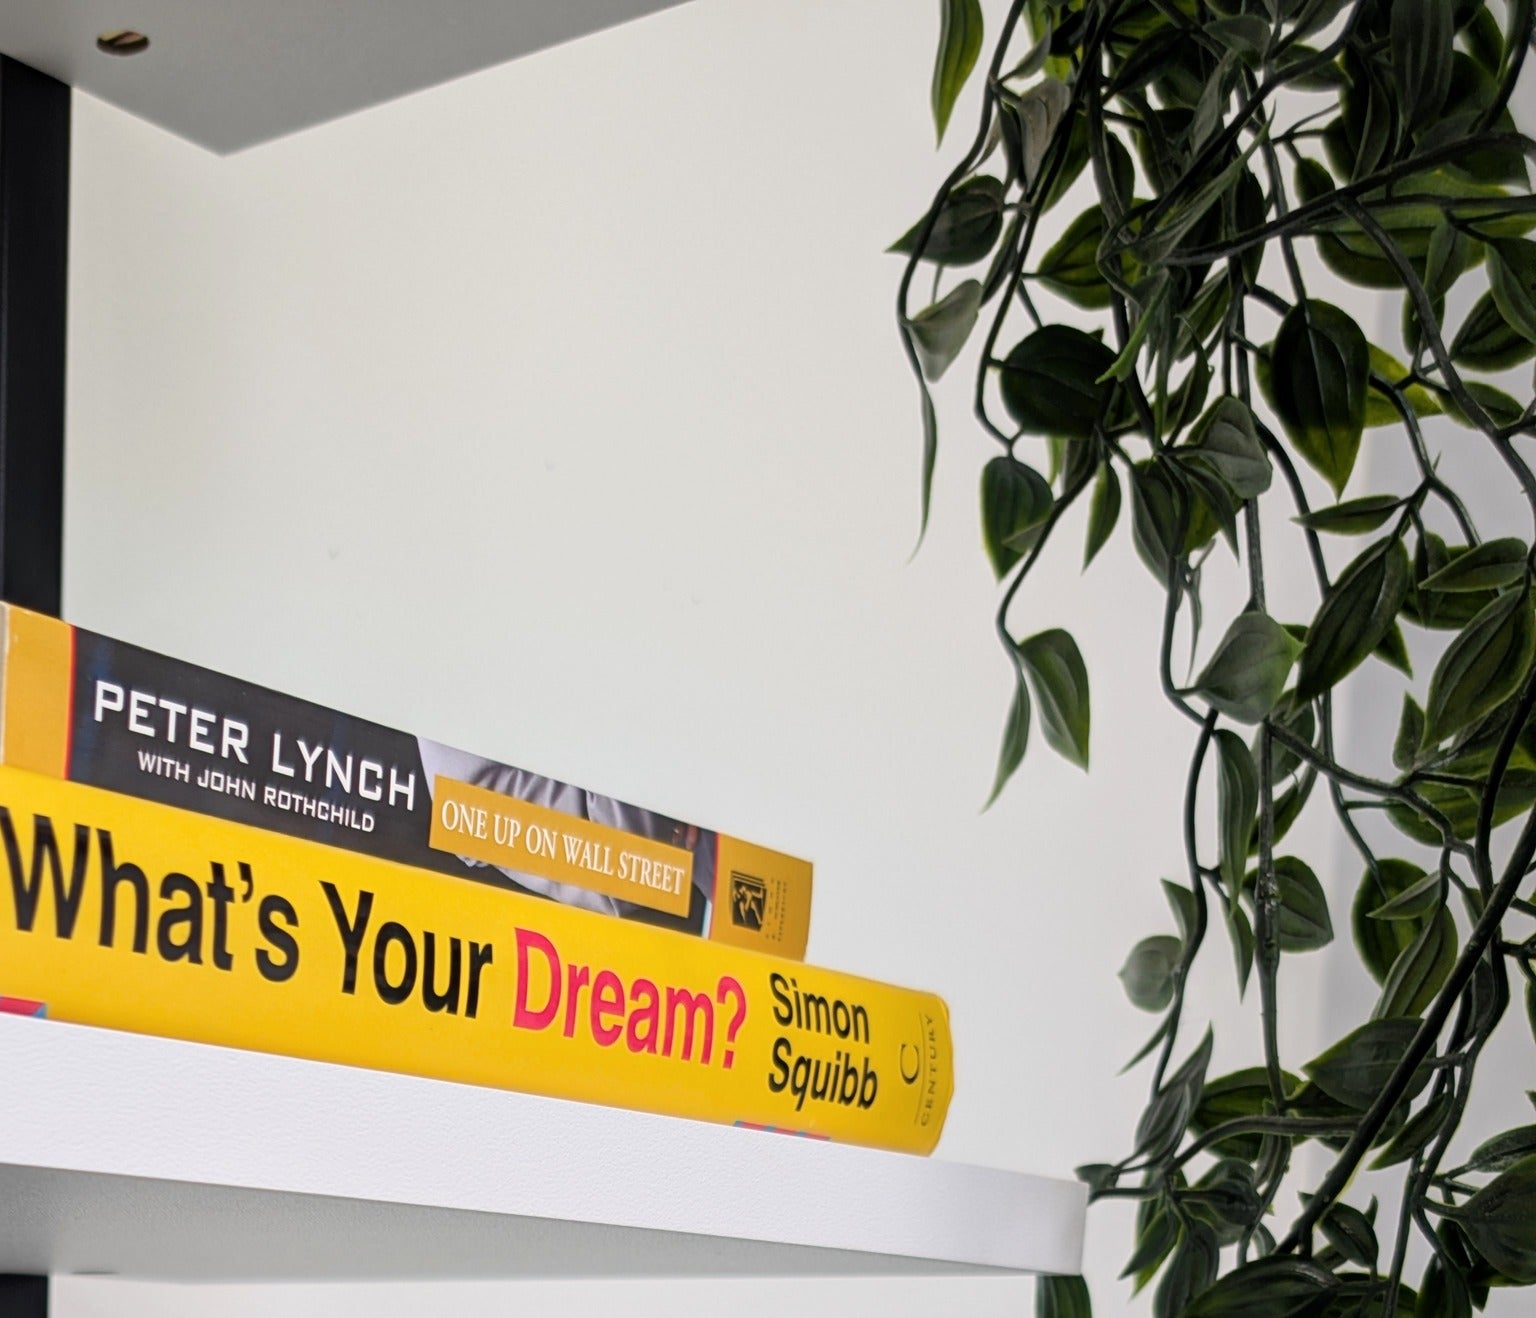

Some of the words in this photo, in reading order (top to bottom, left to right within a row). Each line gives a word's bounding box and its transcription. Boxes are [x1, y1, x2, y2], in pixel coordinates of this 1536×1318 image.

[94, 680, 250, 765] PETER
[271, 732, 416, 812] LYNCH
[137, 750, 191, 785] WITH
[197, 769, 257, 801] JOHN
[263, 786, 375, 834] ROTHCHILD
[441, 799, 488, 841] ONE
[492, 814, 520, 849] UP
[525, 824, 558, 860] ON
[562, 833, 613, 876] WALL
[617, 851, 686, 896] STREET
[319, 880, 493, 1019] Your
[513, 926, 747, 1069] Dream?
[769, 972, 870, 1044] Simon
[768, 1037, 878, 1112] Squibb
[921, 1014, 938, 1127] CENTURY
